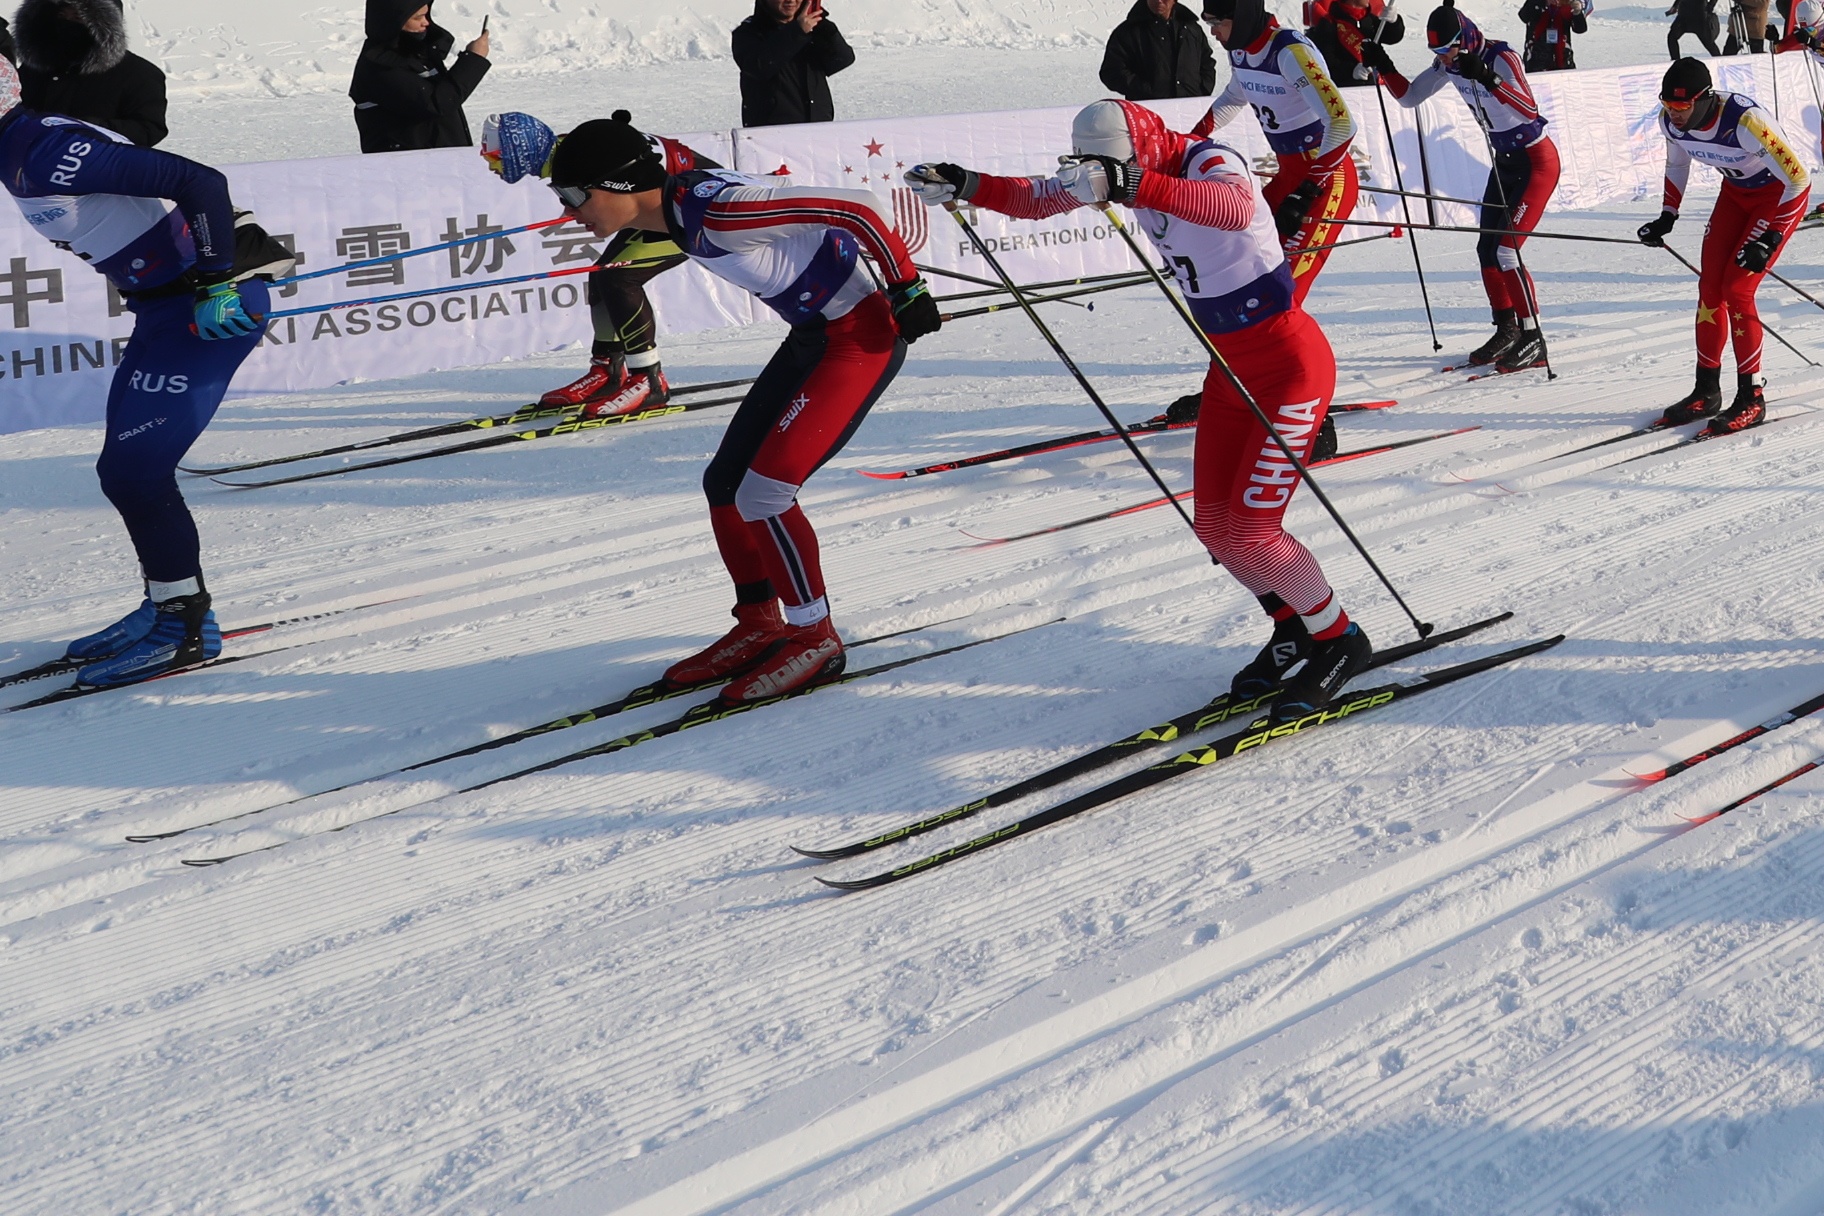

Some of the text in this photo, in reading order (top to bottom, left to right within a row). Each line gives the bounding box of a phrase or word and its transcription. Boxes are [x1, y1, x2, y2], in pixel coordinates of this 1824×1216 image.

[50, 140, 92, 187] RUS
[1688, 150, 1706, 159] NCI
[958, 220, 1088, 257] FEDERATION
[262, 312, 296, 349] KI
[312, 279, 592, 341] ASSOCIATIO
[128, 369, 190, 394] RUS
[118, 421, 155, 441] CRAFT
[550, 405, 687, 435] FISCHER
[1243, 397, 1322, 509] CHINA
[742, 637, 839, 701] alpina
[1233, 690, 1395, 756] FISCHER
[864, 797, 989, 847] FISCHER
[892, 823, 1020, 877] FISCHER
